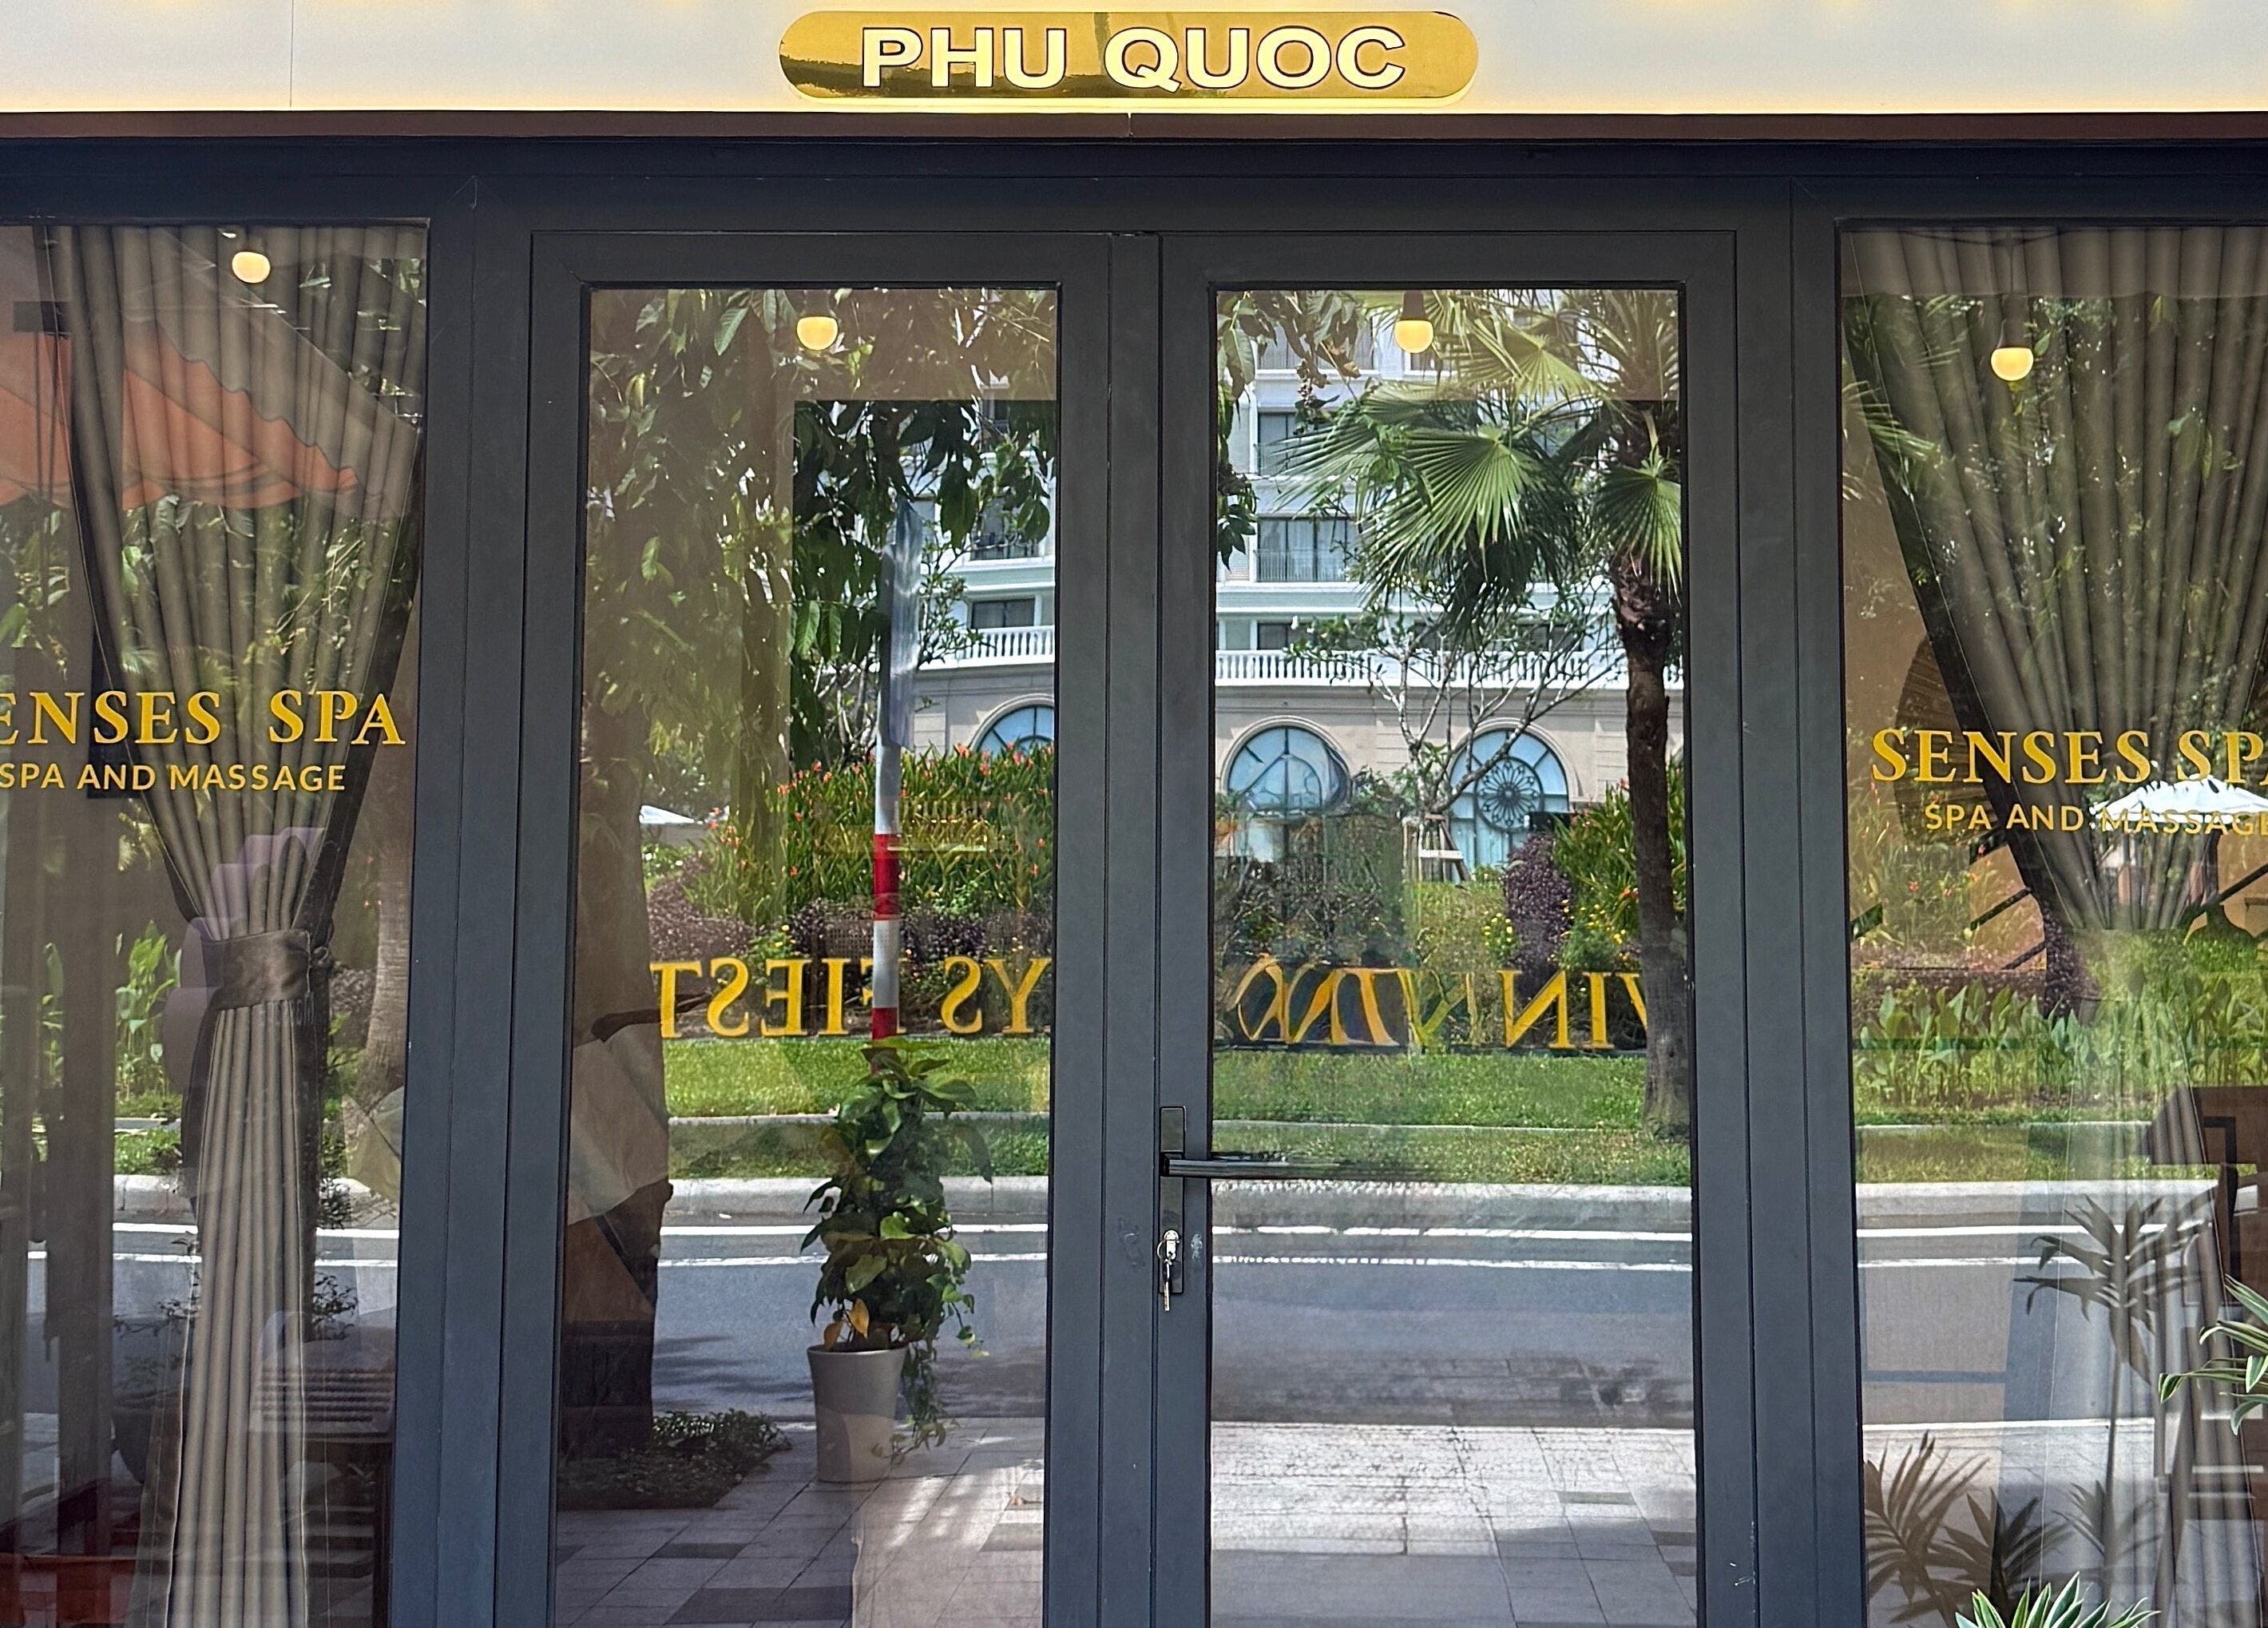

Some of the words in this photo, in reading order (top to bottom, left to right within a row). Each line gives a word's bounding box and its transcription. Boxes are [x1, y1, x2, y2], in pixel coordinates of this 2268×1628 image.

[860, 26, 1068, 89] PHU
[1102, 26, 1406, 93] QUOC
[268, 689, 406, 745] SPA
[0, 763, 65, 789] SPA
[76, 764, 157, 791] AND
[169, 764, 347, 792] MASSAGE
[1870, 728, 2154, 784] SENSES
[2175, 729, 2268, 786] SP
[1925, 804, 1992, 832] SPA
[2005, 804, 2084, 832] AND
